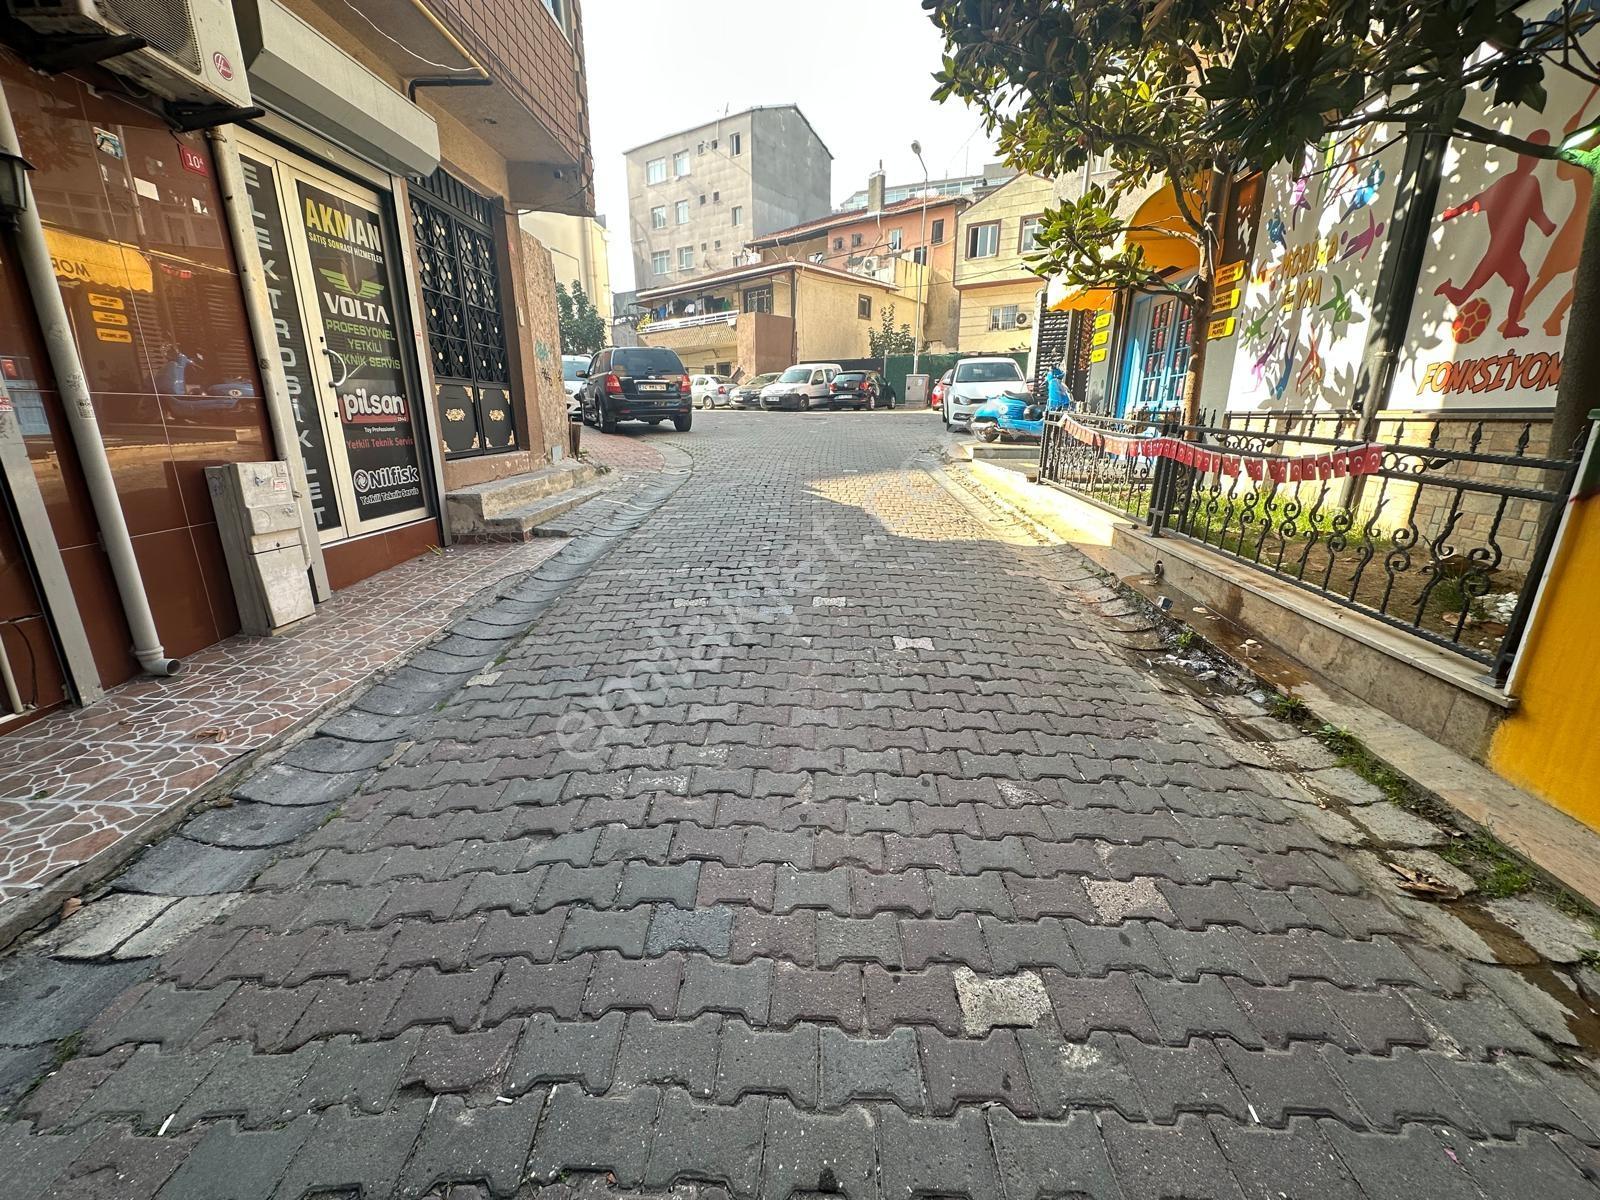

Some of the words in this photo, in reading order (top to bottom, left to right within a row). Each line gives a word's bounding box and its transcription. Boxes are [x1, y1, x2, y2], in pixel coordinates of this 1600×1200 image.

[305, 197, 382, 252] AKMAN
[308, 232, 327, 247] SATIŞ
[327, 238, 353, 255] SONRASI
[323, 291, 391, 325] VOLTA
[326, 318, 396, 341] PROFESYONEL
[347, 338, 383, 354] YETKİLİ
[369, 356, 401, 370] SERVİS
[343, 388, 405, 422] pilsan
[346, 439, 370, 449] Yetkili
[371, 437, 393, 448] Teknik
[394, 437, 414, 447] Servis
[367, 465, 420, 489] Nilfisk
[360, 494, 381, 505] Yetkili
[381, 491, 402, 502] Teknik
[401, 487, 420, 498] Servis
